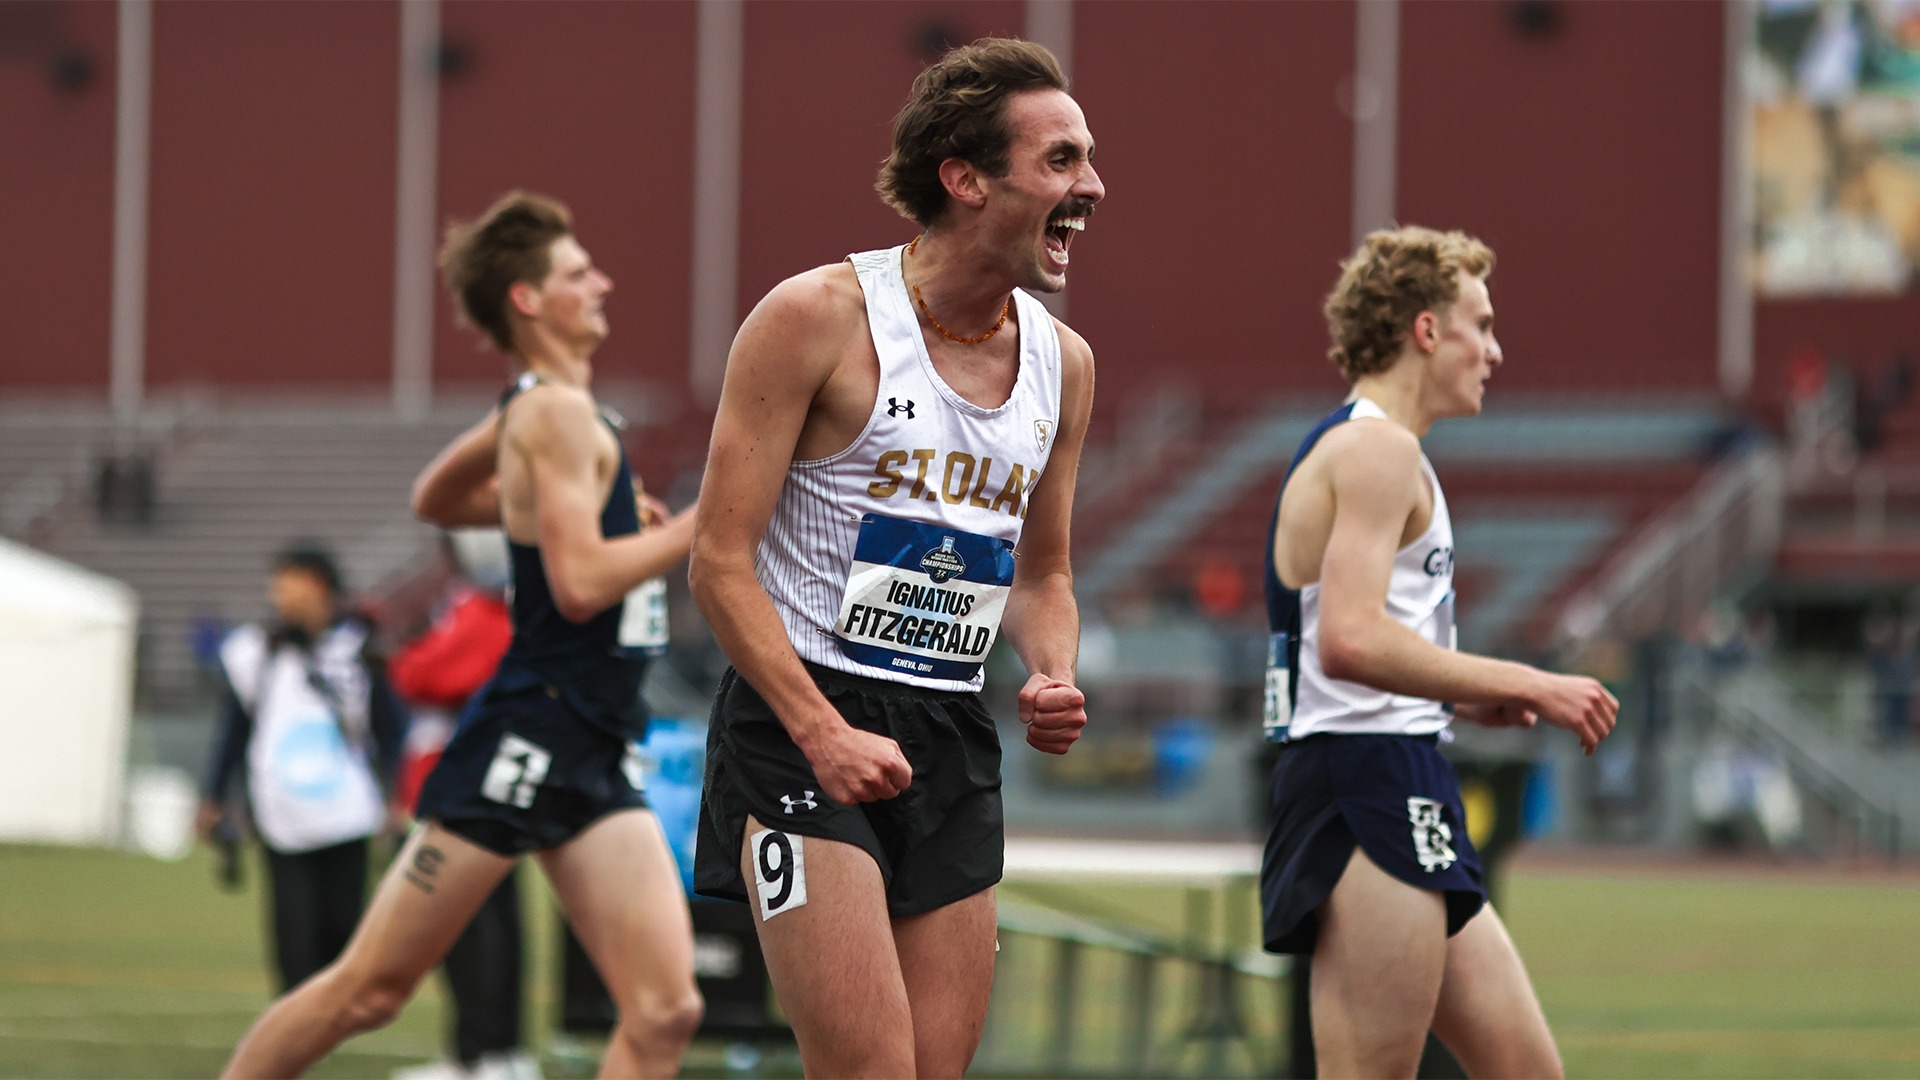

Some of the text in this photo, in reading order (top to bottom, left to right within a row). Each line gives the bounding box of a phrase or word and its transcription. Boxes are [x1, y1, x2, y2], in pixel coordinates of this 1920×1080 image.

[922, 558, 964, 573] CHAMPIONSHIPS
[886, 580, 975, 617] IGNATIUS
[844, 603, 990, 656] FITZGERALD
[891, 657, 934, 673] GENEVA, OHIO
[758, 831, 795, 911] 9
